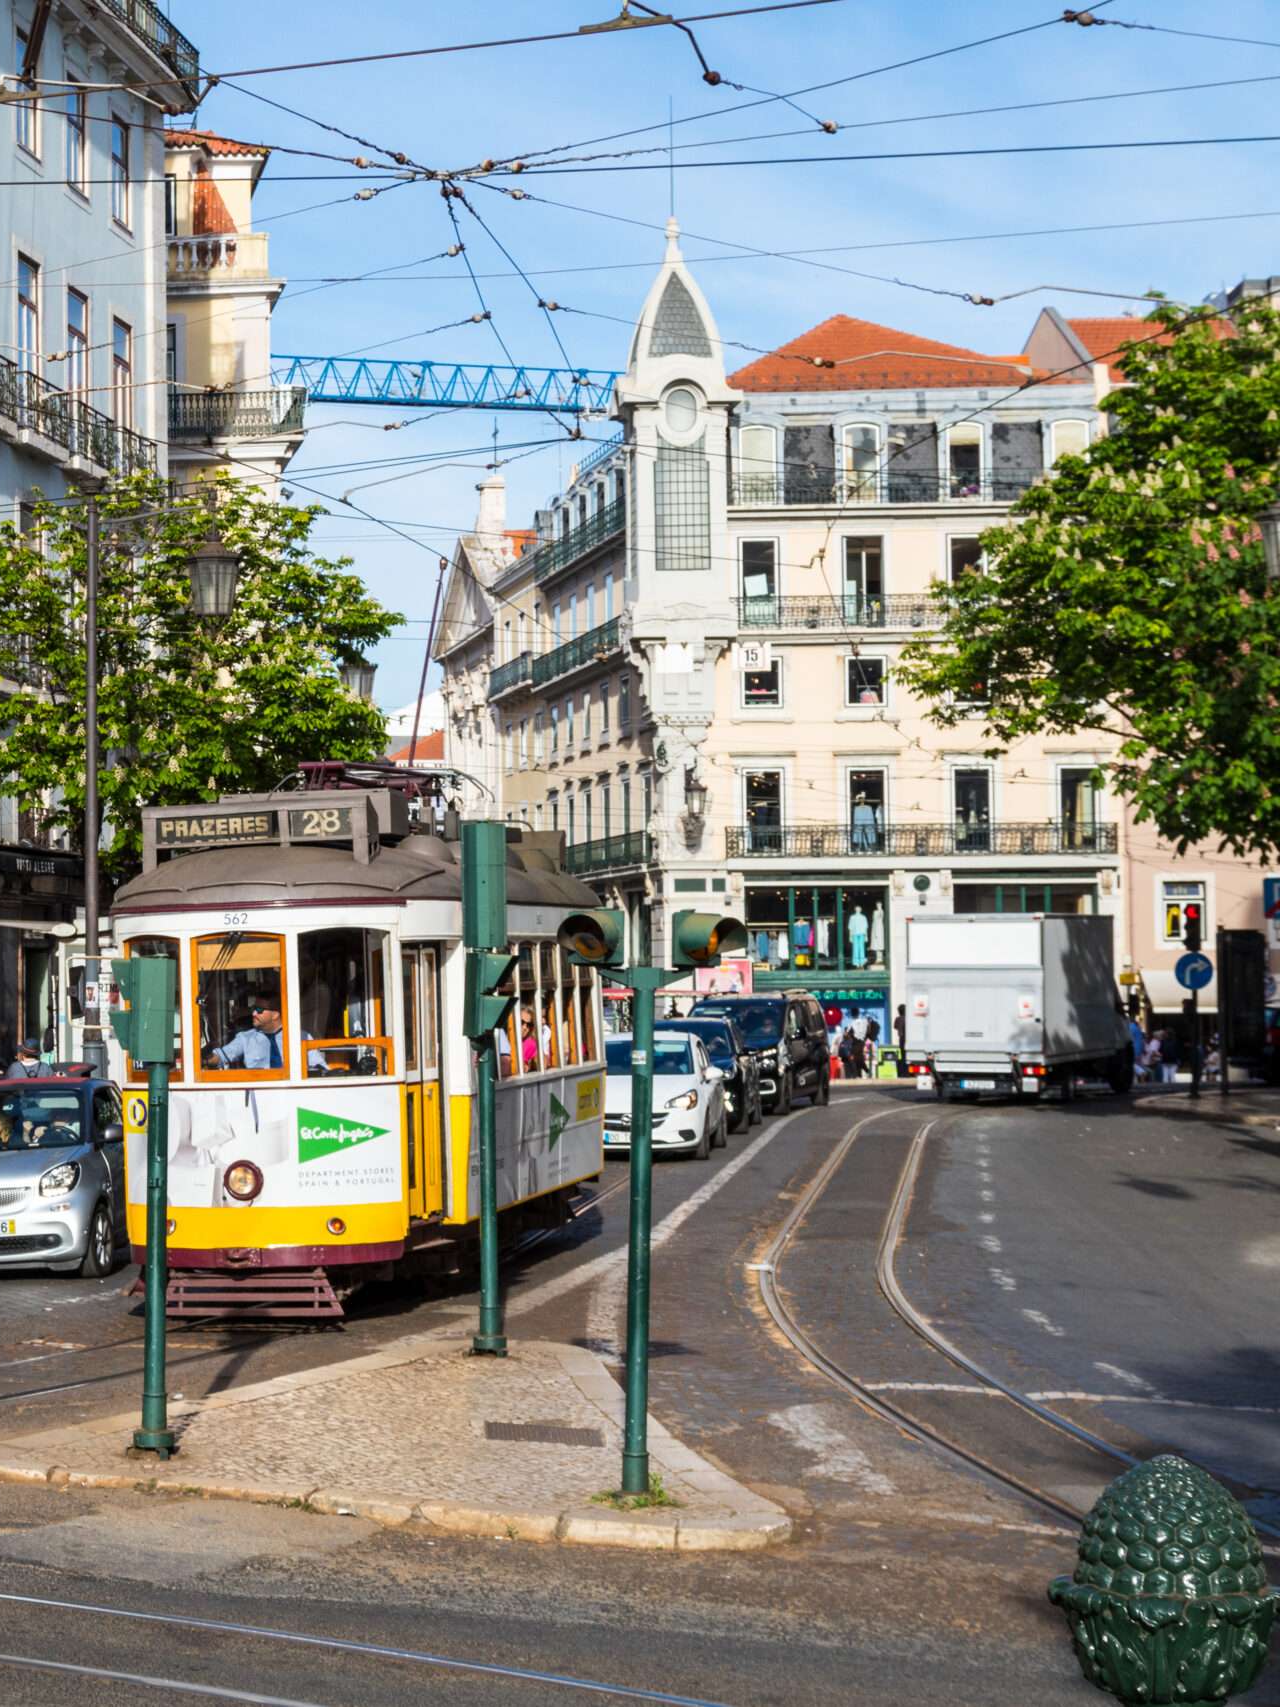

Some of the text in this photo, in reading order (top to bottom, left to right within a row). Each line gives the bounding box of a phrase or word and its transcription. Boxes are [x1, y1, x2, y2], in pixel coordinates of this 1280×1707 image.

[744, 649, 758, 661] 15
[161, 816, 269, 838] PRAZERES
[303, 809, 341, 835] 28
[224, 912, 248, 925] 562
[298, 1167, 395, 1178] DEPARTMENT STORES
[298, 1180, 329, 1188] SPAIN
[346, 1177, 395, 1185] PORTUGAL
